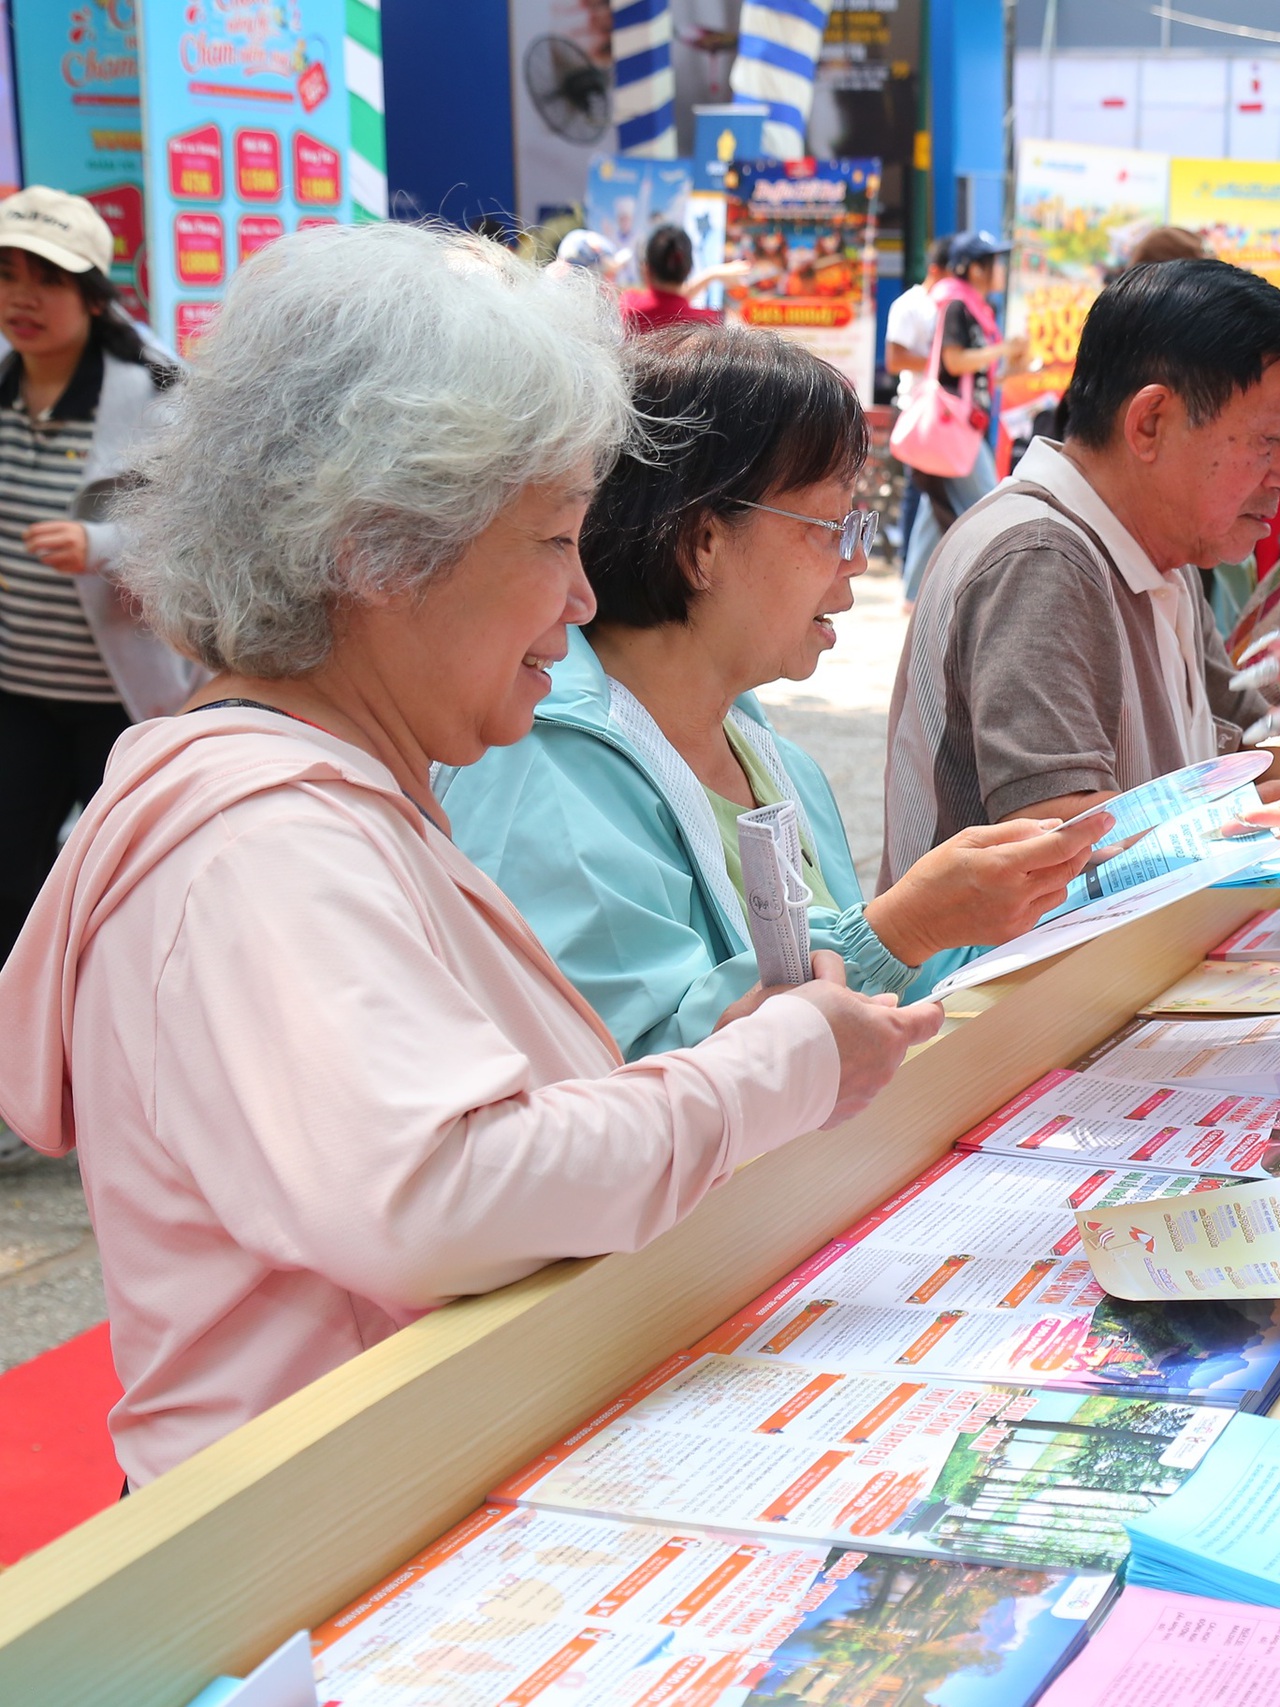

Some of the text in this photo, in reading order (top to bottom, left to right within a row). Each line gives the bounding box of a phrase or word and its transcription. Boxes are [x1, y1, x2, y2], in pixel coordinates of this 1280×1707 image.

[917, 1389, 983, 1437] HERO SHOW
[951, 1392, 1013, 1433] EVERLAND
[965, 1396, 1041, 1452] SEOUL NAMI
[852, 1422, 917, 1466] STARFIELD
[752, 1550, 870, 1651] OSAKA KYOTO NAGOYA
[774, 1574, 813, 1591] PHÚ
[728, 1606, 775, 1635] TOKYO
